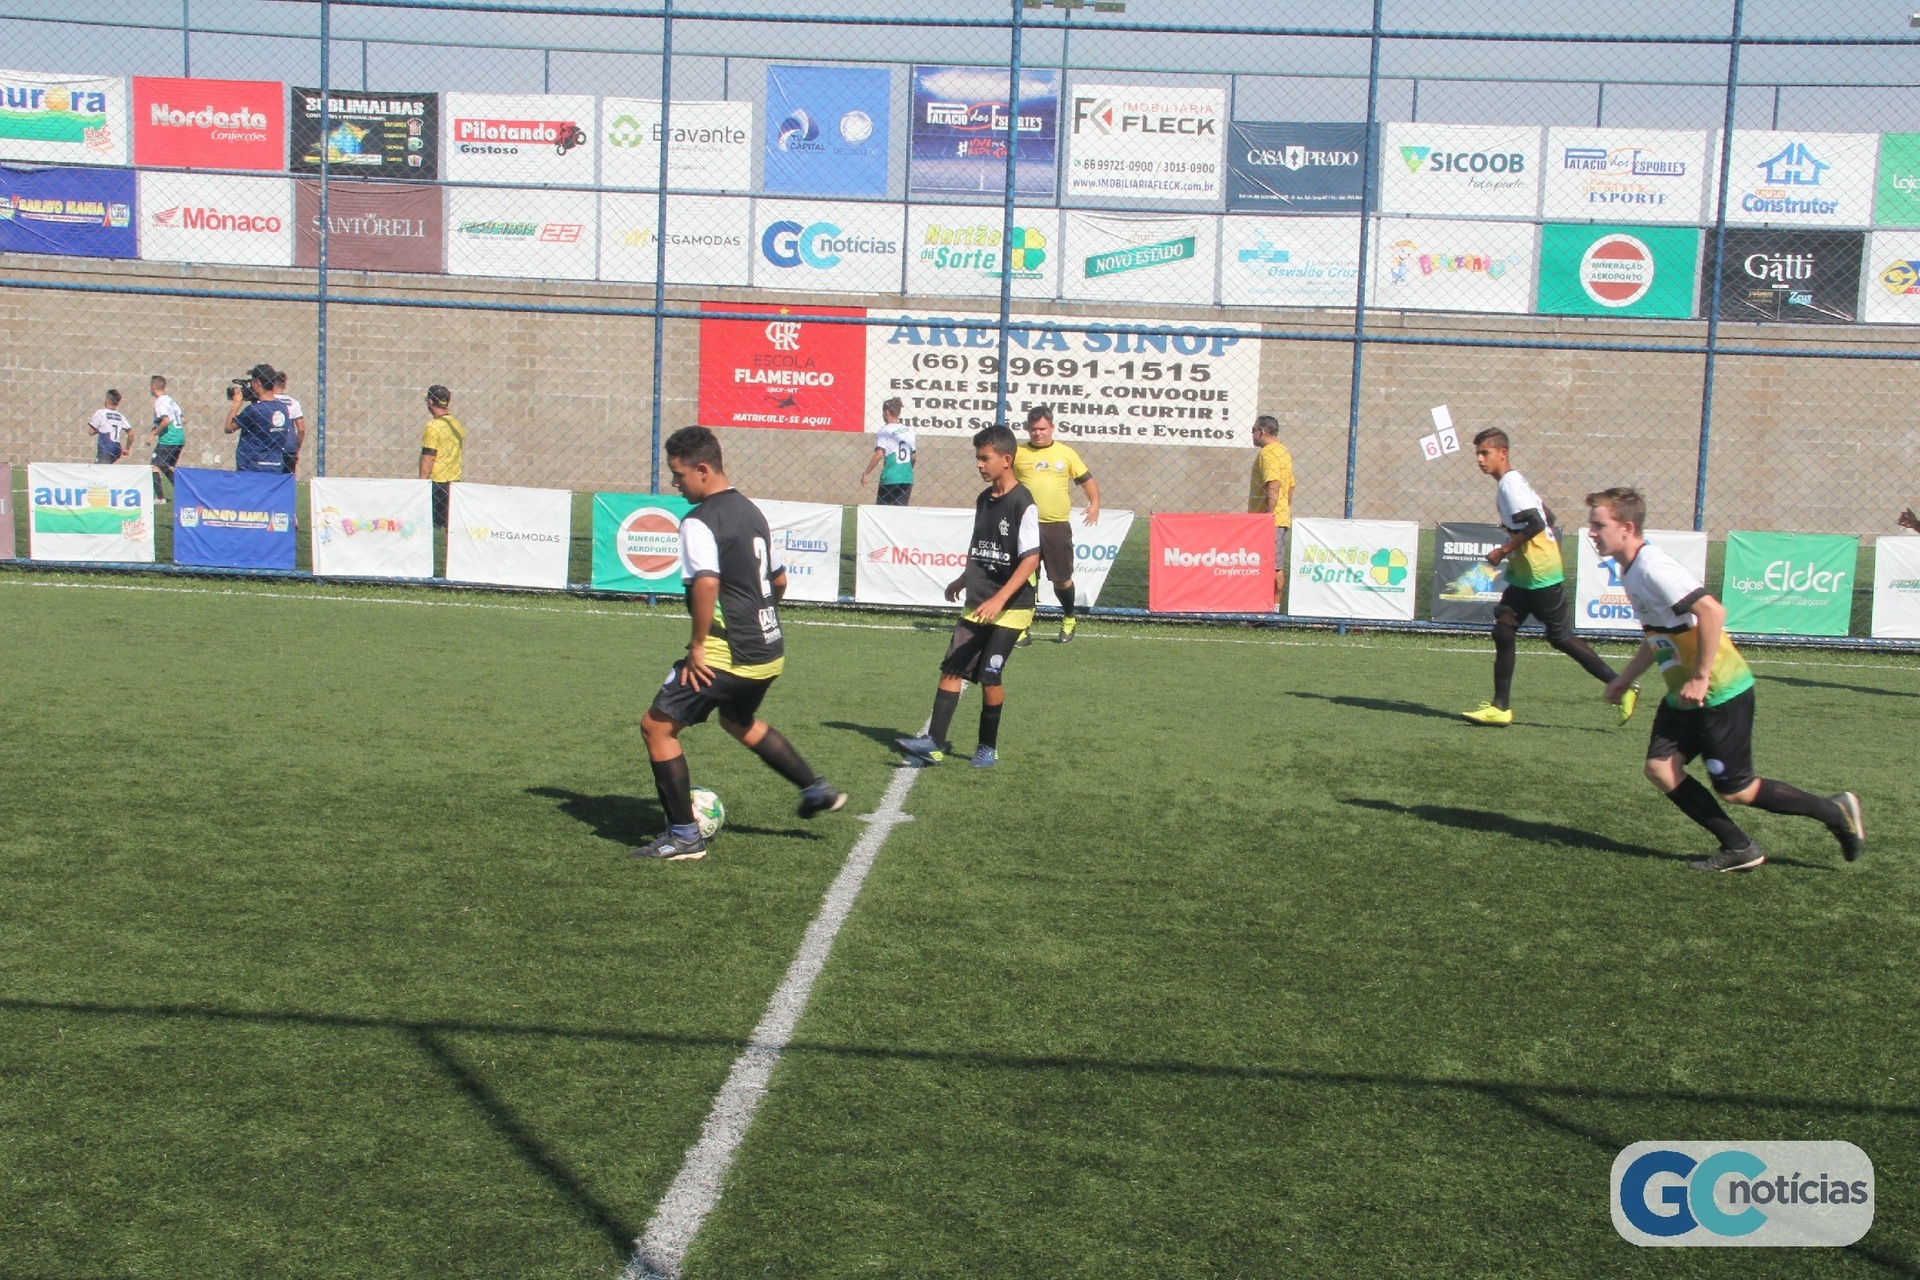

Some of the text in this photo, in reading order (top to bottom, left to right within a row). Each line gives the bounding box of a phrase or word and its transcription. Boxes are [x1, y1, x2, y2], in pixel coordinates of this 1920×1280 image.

[151, 103, 266, 130] Nordeste
[970, 109, 989, 122] dos
[1122, 115, 1216, 136] FLECK
[460, 121, 557, 141] Pilotando
[460, 145, 519, 155] Gostoso
[790, 143, 826, 151] CAPITAL
[1084, 159, 1096, 170] 66
[1098, 160, 1153, 172] 99721-0900
[1164, 162, 1215, 174] 3015-0900
[1247, 149, 1359, 166] CASA PRADO
[1430, 152, 1525, 173] SICOOB
[1632, 150, 1686, 176] ESPORTES
[1590, 192, 1667, 205] ESPORTE
[1741, 194, 1839, 214] Construtor
[183, 207, 281, 233] Mônaco
[761, 220, 896, 269] GC notícias
[924, 224, 1002, 247] Nortão
[1095, 243, 1184, 273] NOVO ESTADO
[1592, 262, 1643, 271] MINERAÇÃO
[1268, 260, 1359, 278] Oswaldo Cruz
[1789, 291, 1813, 302] Zeus
[754, 354, 816, 368] ESCOLA
[912, 353, 969, 373] (66)
[734, 368, 835, 386] FLAMENGO
[890, 378, 968, 392] ESCALE
[1027, 383, 1092, 400] TIME,
[1100, 386, 1229, 402] CONVOQUE
[733, 413, 800, 424] MATRICULE-SE
[1021, 401, 1032, 412] E
[1127, 405, 1214, 420] CURTIR
[898, 416, 963, 429] utebol
[1058, 421, 1132, 437] Squash
[1137, 427, 1148, 436] e
[1153, 425, 1234, 439] Eventos
[899, 440, 907, 461] 6
[1426, 442, 1437, 456] 6
[1444, 436, 1456, 450] 2
[34, 486, 142, 507] aurora
[491, 531, 560, 543] MEGAMODAS
[627, 535, 678, 544] MINERAÇÃO
[786, 530, 828, 553] ESPORTES
[627, 546, 679, 554] AEROPORTO
[892, 547, 968, 567] Mônaco
[1164, 547, 1260, 567] Nordeste
[1302, 545, 1369, 565] Nortão
[753, 537, 772, 598] 2
[1213, 567, 1260, 577] Confecções
[1732, 560, 1846, 594] Lojas Elder
[1601, 595, 1619, 603] CASA
